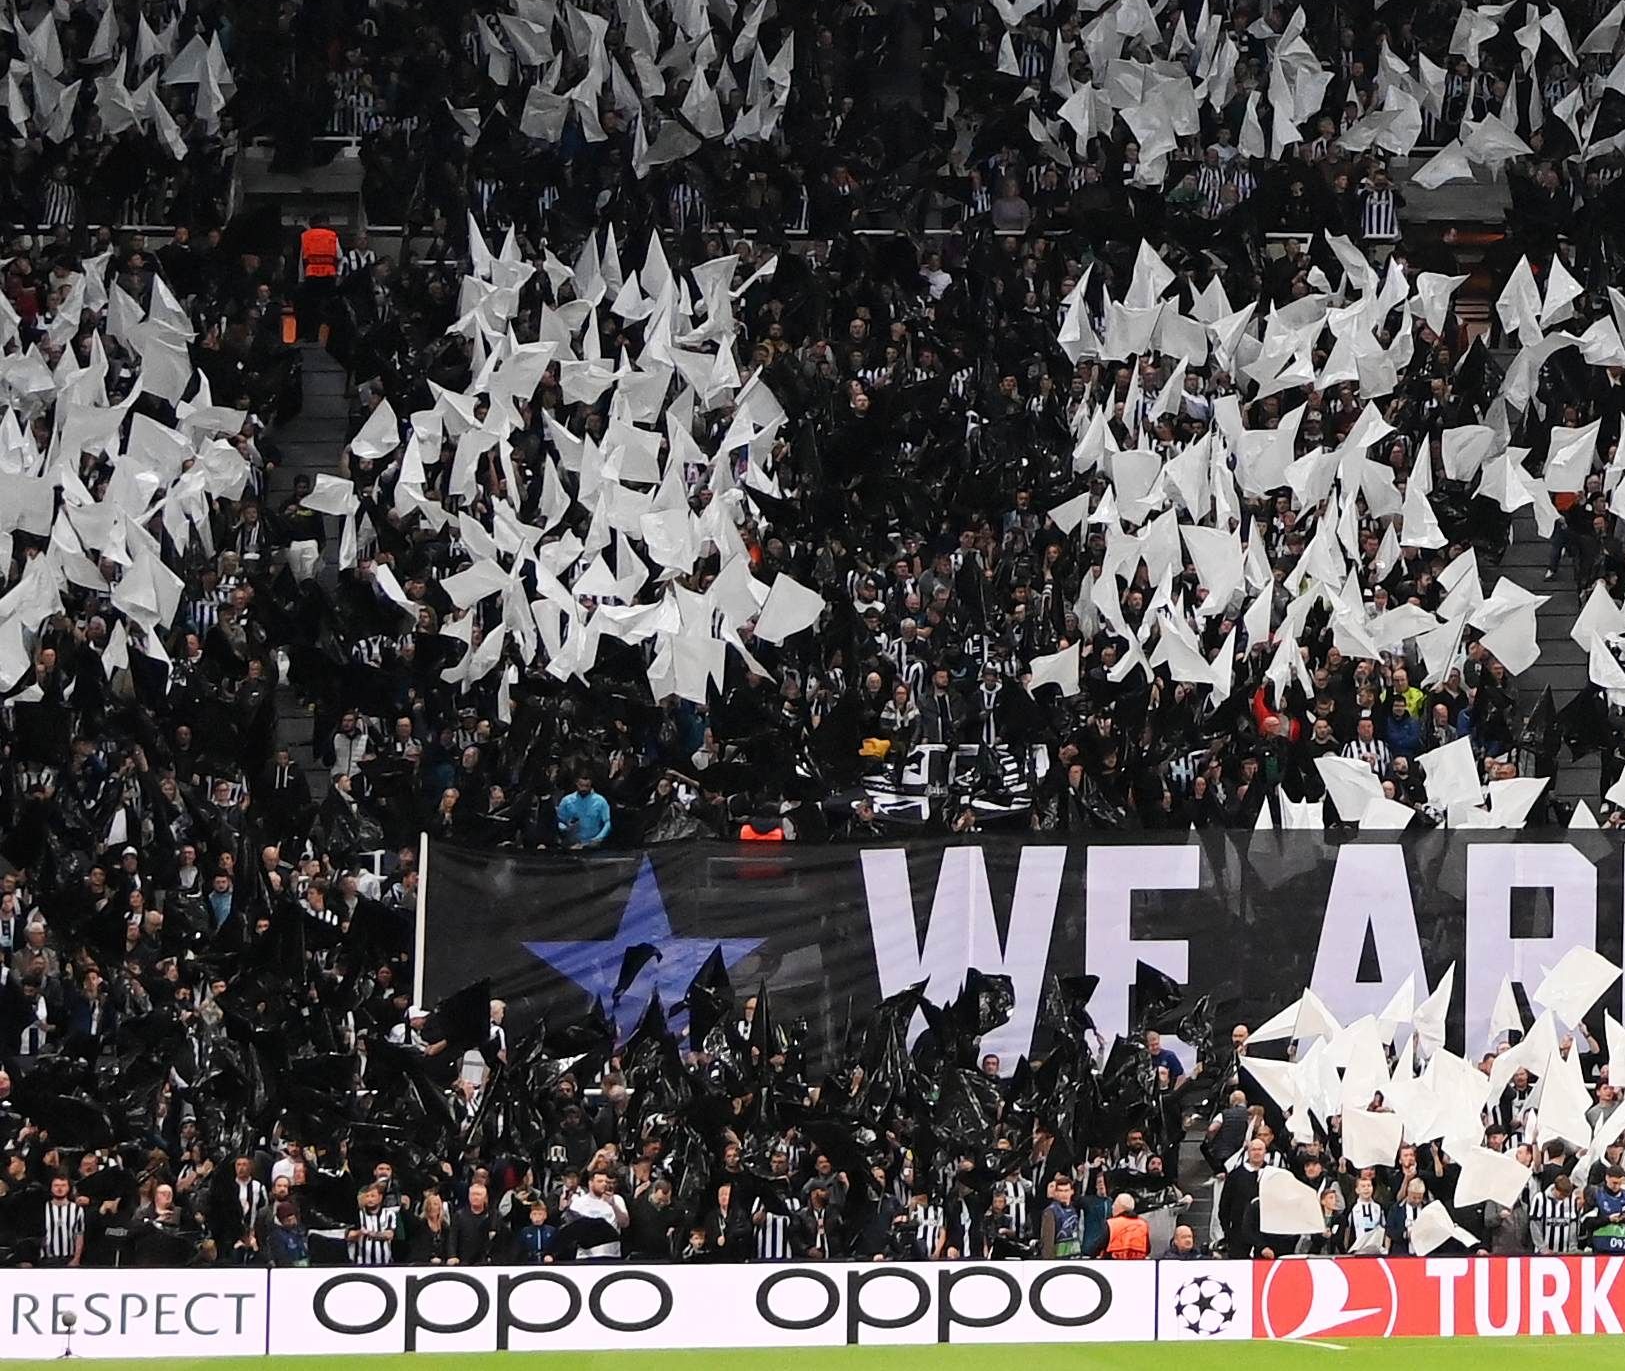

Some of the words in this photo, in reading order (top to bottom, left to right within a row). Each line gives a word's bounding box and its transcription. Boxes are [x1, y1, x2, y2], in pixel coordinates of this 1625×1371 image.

[860, 844, 1201, 1078] WE
[1363, 1205, 1372, 1221] 4
[12, 1293, 255, 1335] RESPECT
[312, 1271, 674, 1350] oppo
[756, 1263, 1113, 1344] oppo
